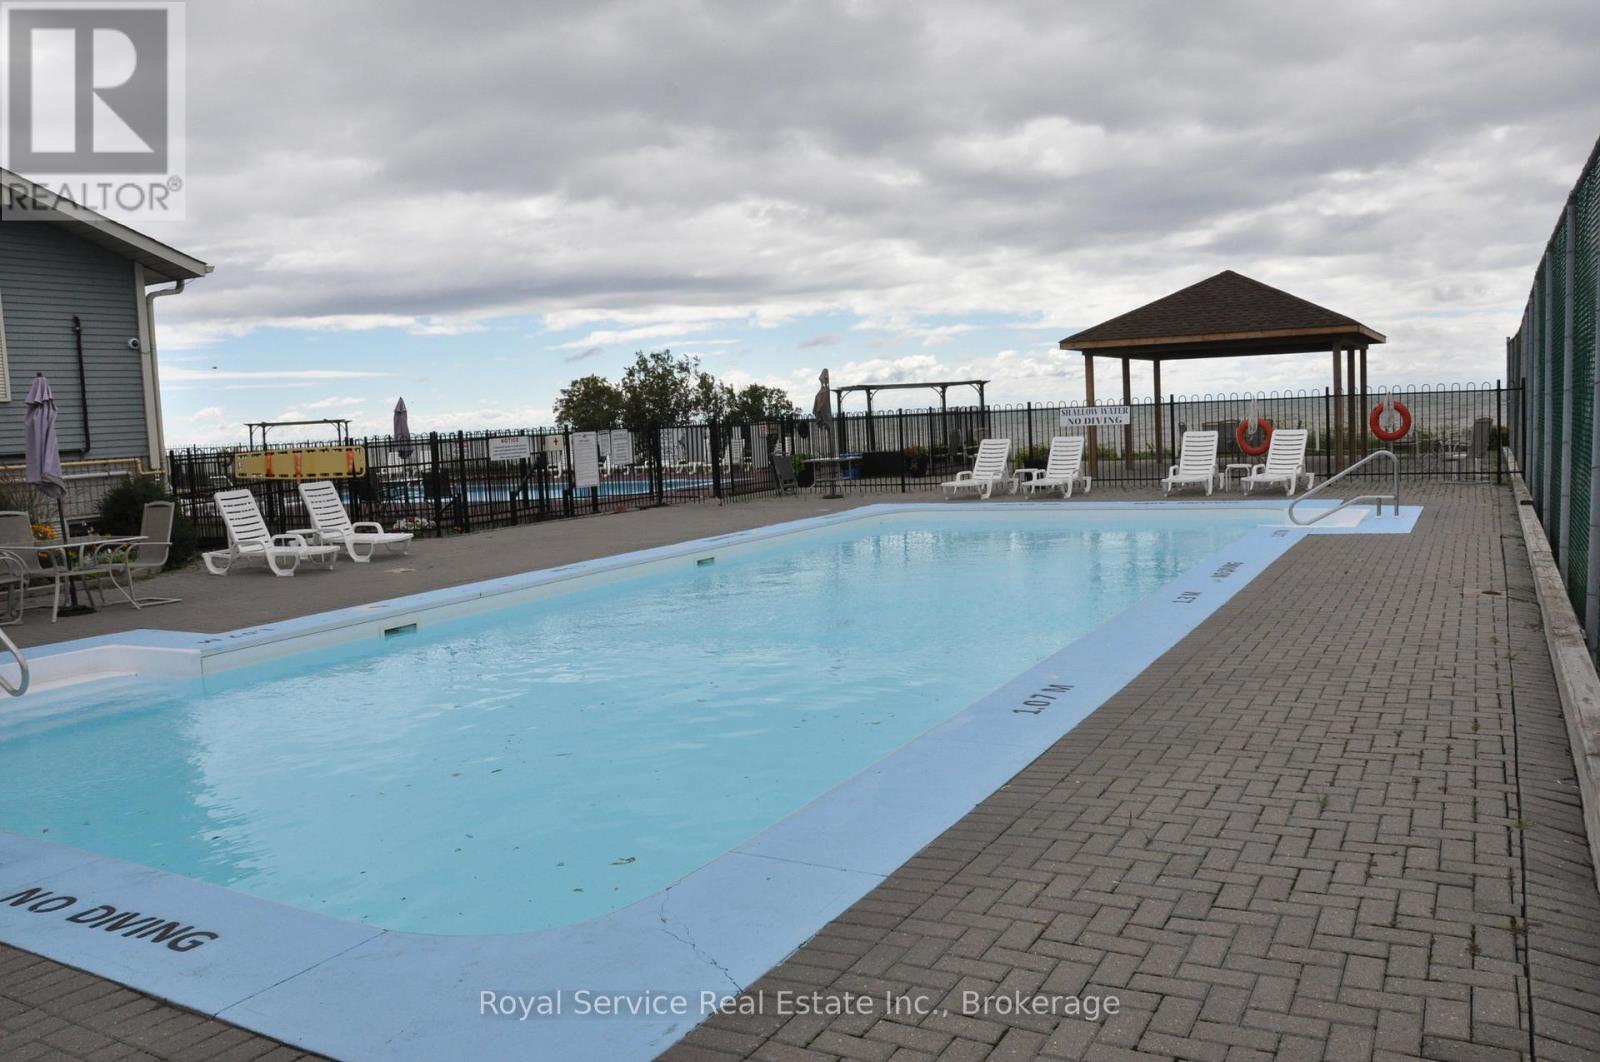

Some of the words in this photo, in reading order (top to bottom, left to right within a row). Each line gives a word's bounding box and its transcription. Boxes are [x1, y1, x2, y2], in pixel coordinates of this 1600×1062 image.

[1060, 408, 1098, 417] SHALLOW
[1101, 406, 1129, 415] WATER
[1068, 417, 1082, 425] NO
[1084, 416, 1122, 425] DIVING
[0, 887, 78, 913] NO
[65, 904, 219, 952] DIVING
